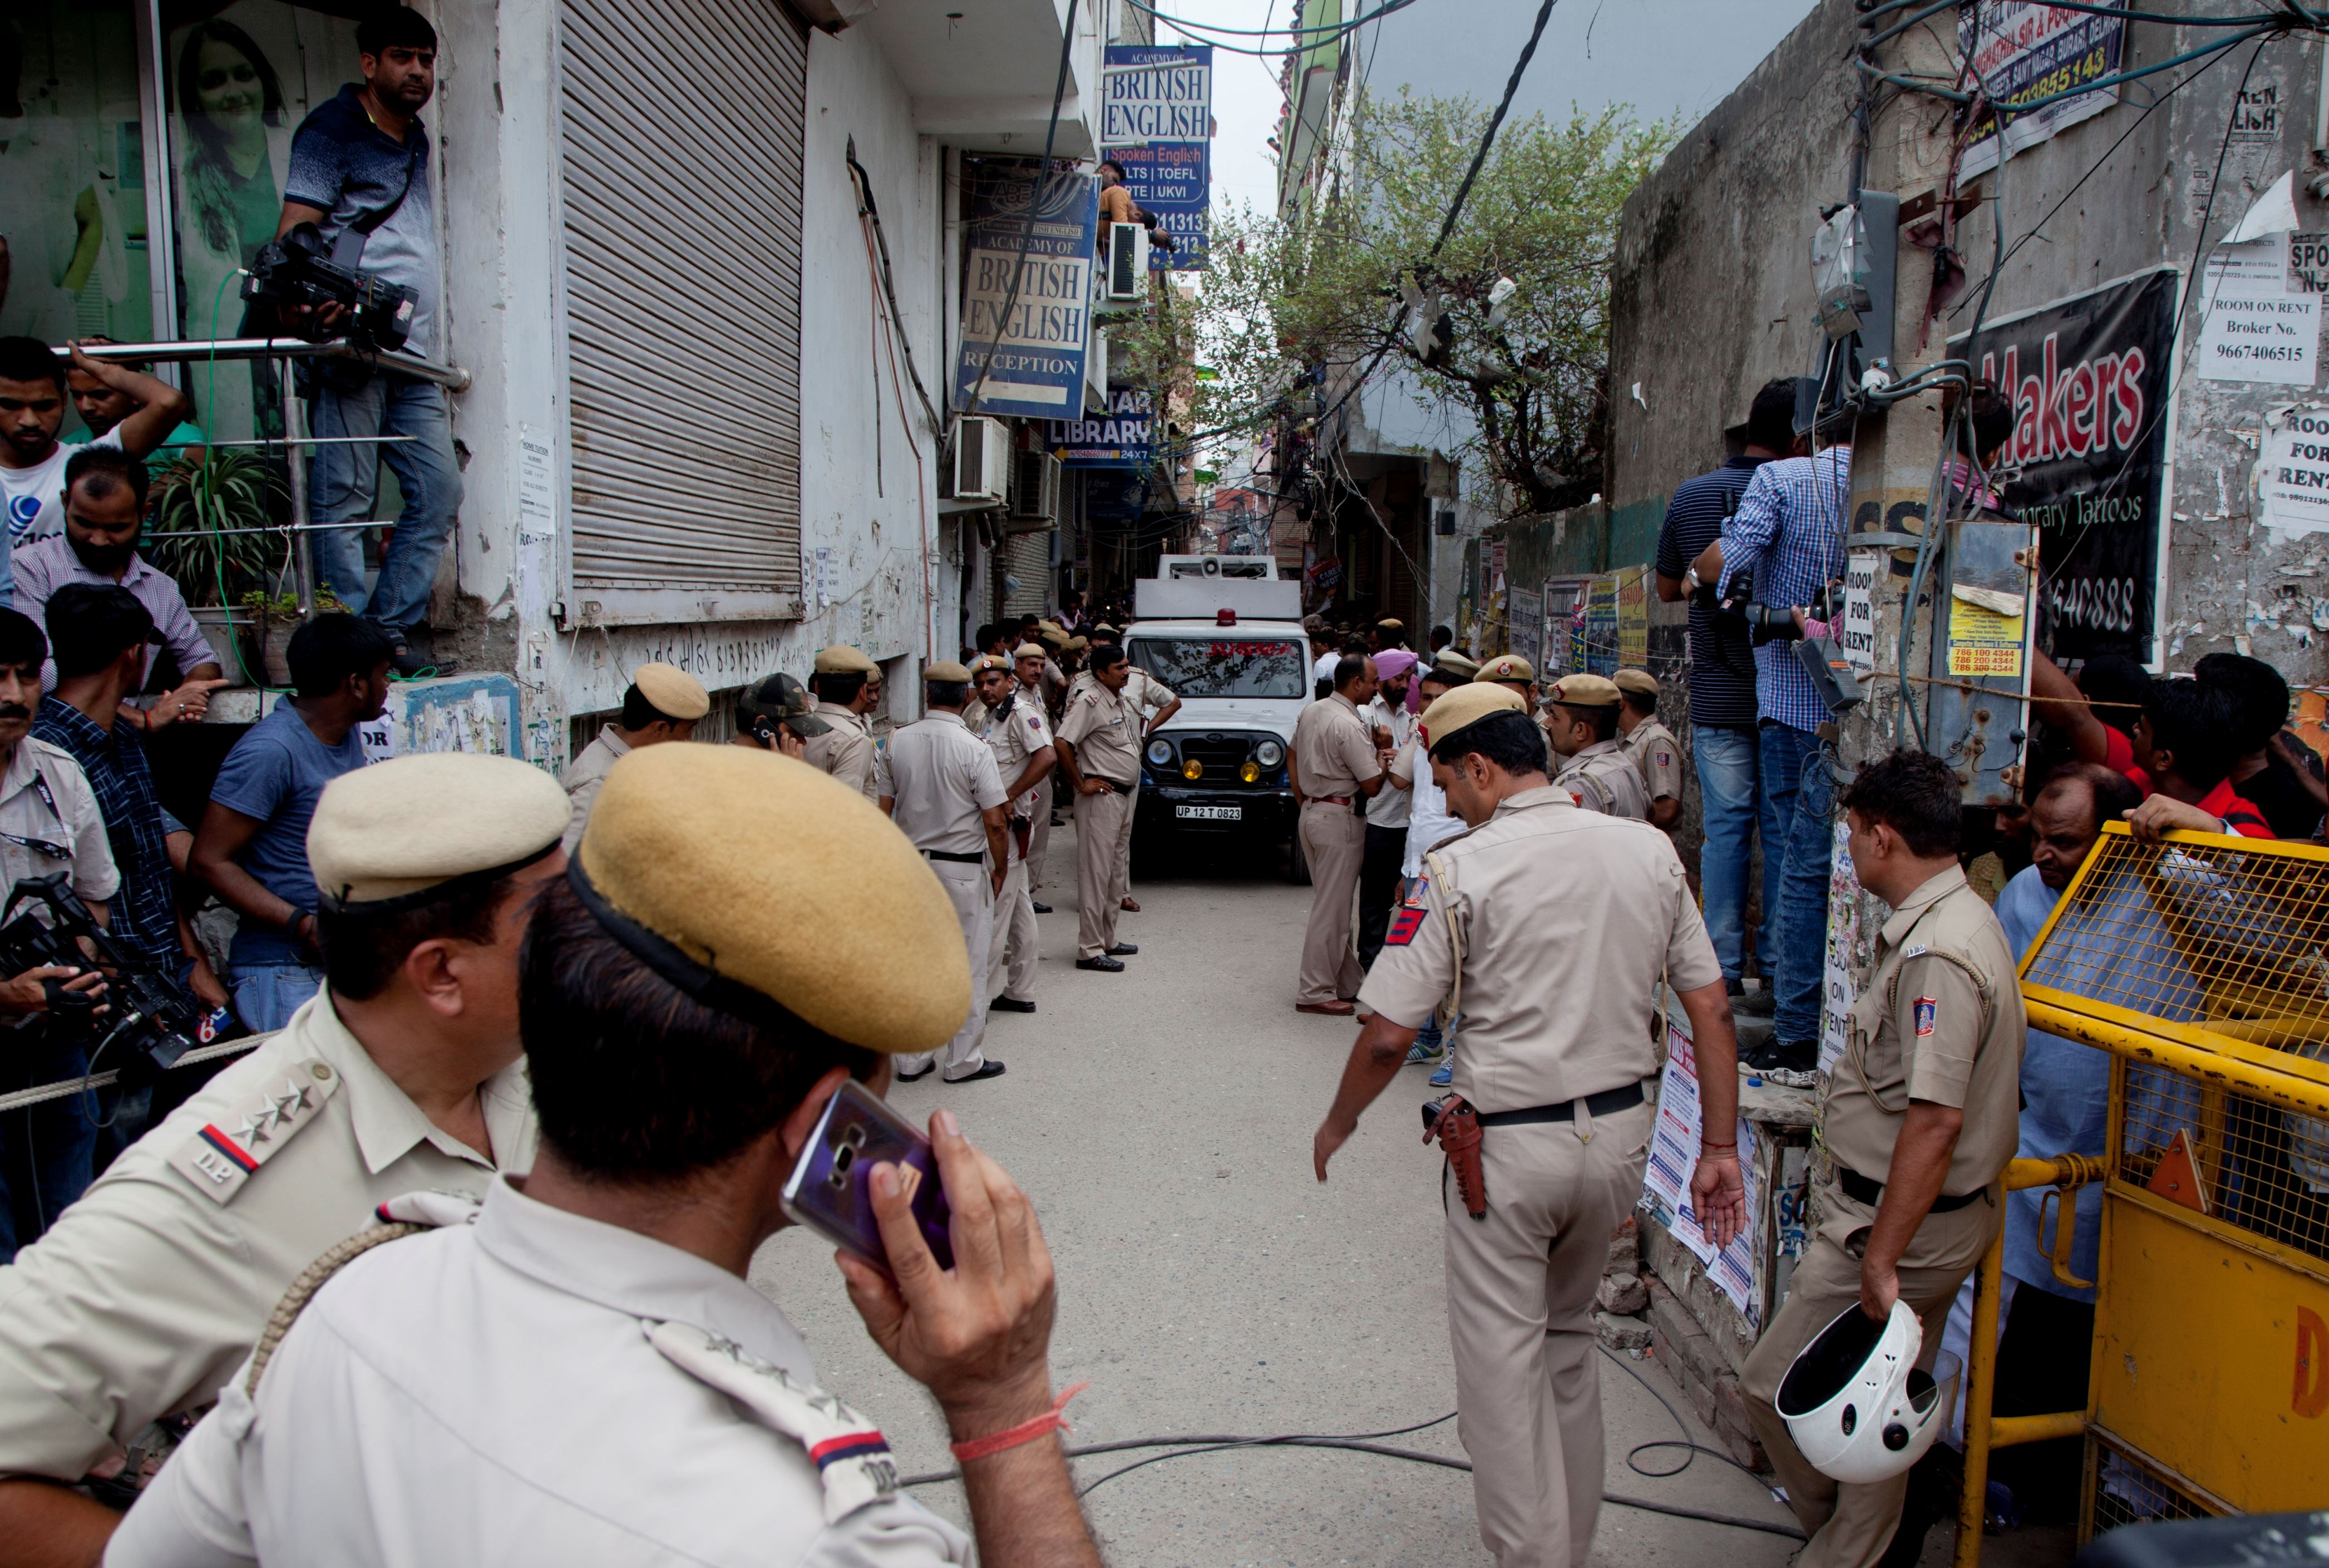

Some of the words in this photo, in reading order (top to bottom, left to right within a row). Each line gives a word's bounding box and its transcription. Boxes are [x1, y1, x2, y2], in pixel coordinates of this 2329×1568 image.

[2019, 17, 2034, 48] SIR
[1131, 54, 1168, 63] ACADEMY
[1111, 69, 1203, 100] BRITISH
[1106, 105, 1207, 137] ENGLISH
[1111, 147, 1154, 164] Spoken
[1158, 146, 1201, 166] English
[1157, 168, 1196, 180] TOEFL
[1158, 186, 1186, 198] UKVI
[1050, 226, 1079, 235] ENGLISH
[1057, 241, 1075, 254] OF
[976, 257, 1080, 299] BRTISH
[2215, 300, 2253, 312] ROOM
[2257, 302, 2274, 313] ON
[2278, 303, 2311, 314] RENT
[969, 299, 1082, 343] ENGLISH
[2227, 320, 2271, 334] Broker
[2276, 323, 2296, 335] No.
[2217, 344, 2302, 361] 9667406515
[964, 352, 1078, 376] RECEPTION
[1050, 418, 1151, 443] LIBRARY
[1121, 450, 1148, 459] 24X7
[2074, 491, 2142, 525] Tattoos
[1850, 601, 1869, 620] FOR
[2049, 578, 2135, 632] 540888
[1845, 630, 1873, 653] RENT
[1177, 807, 1190, 816] UP
[1193, 807, 1205, 817] 12
[1208, 808, 1214, 817] T
[1217, 808, 1240, 819] 0823
[1832, 982, 1844, 1003] ON
[1671, 1030, 1684, 1063] IAS
